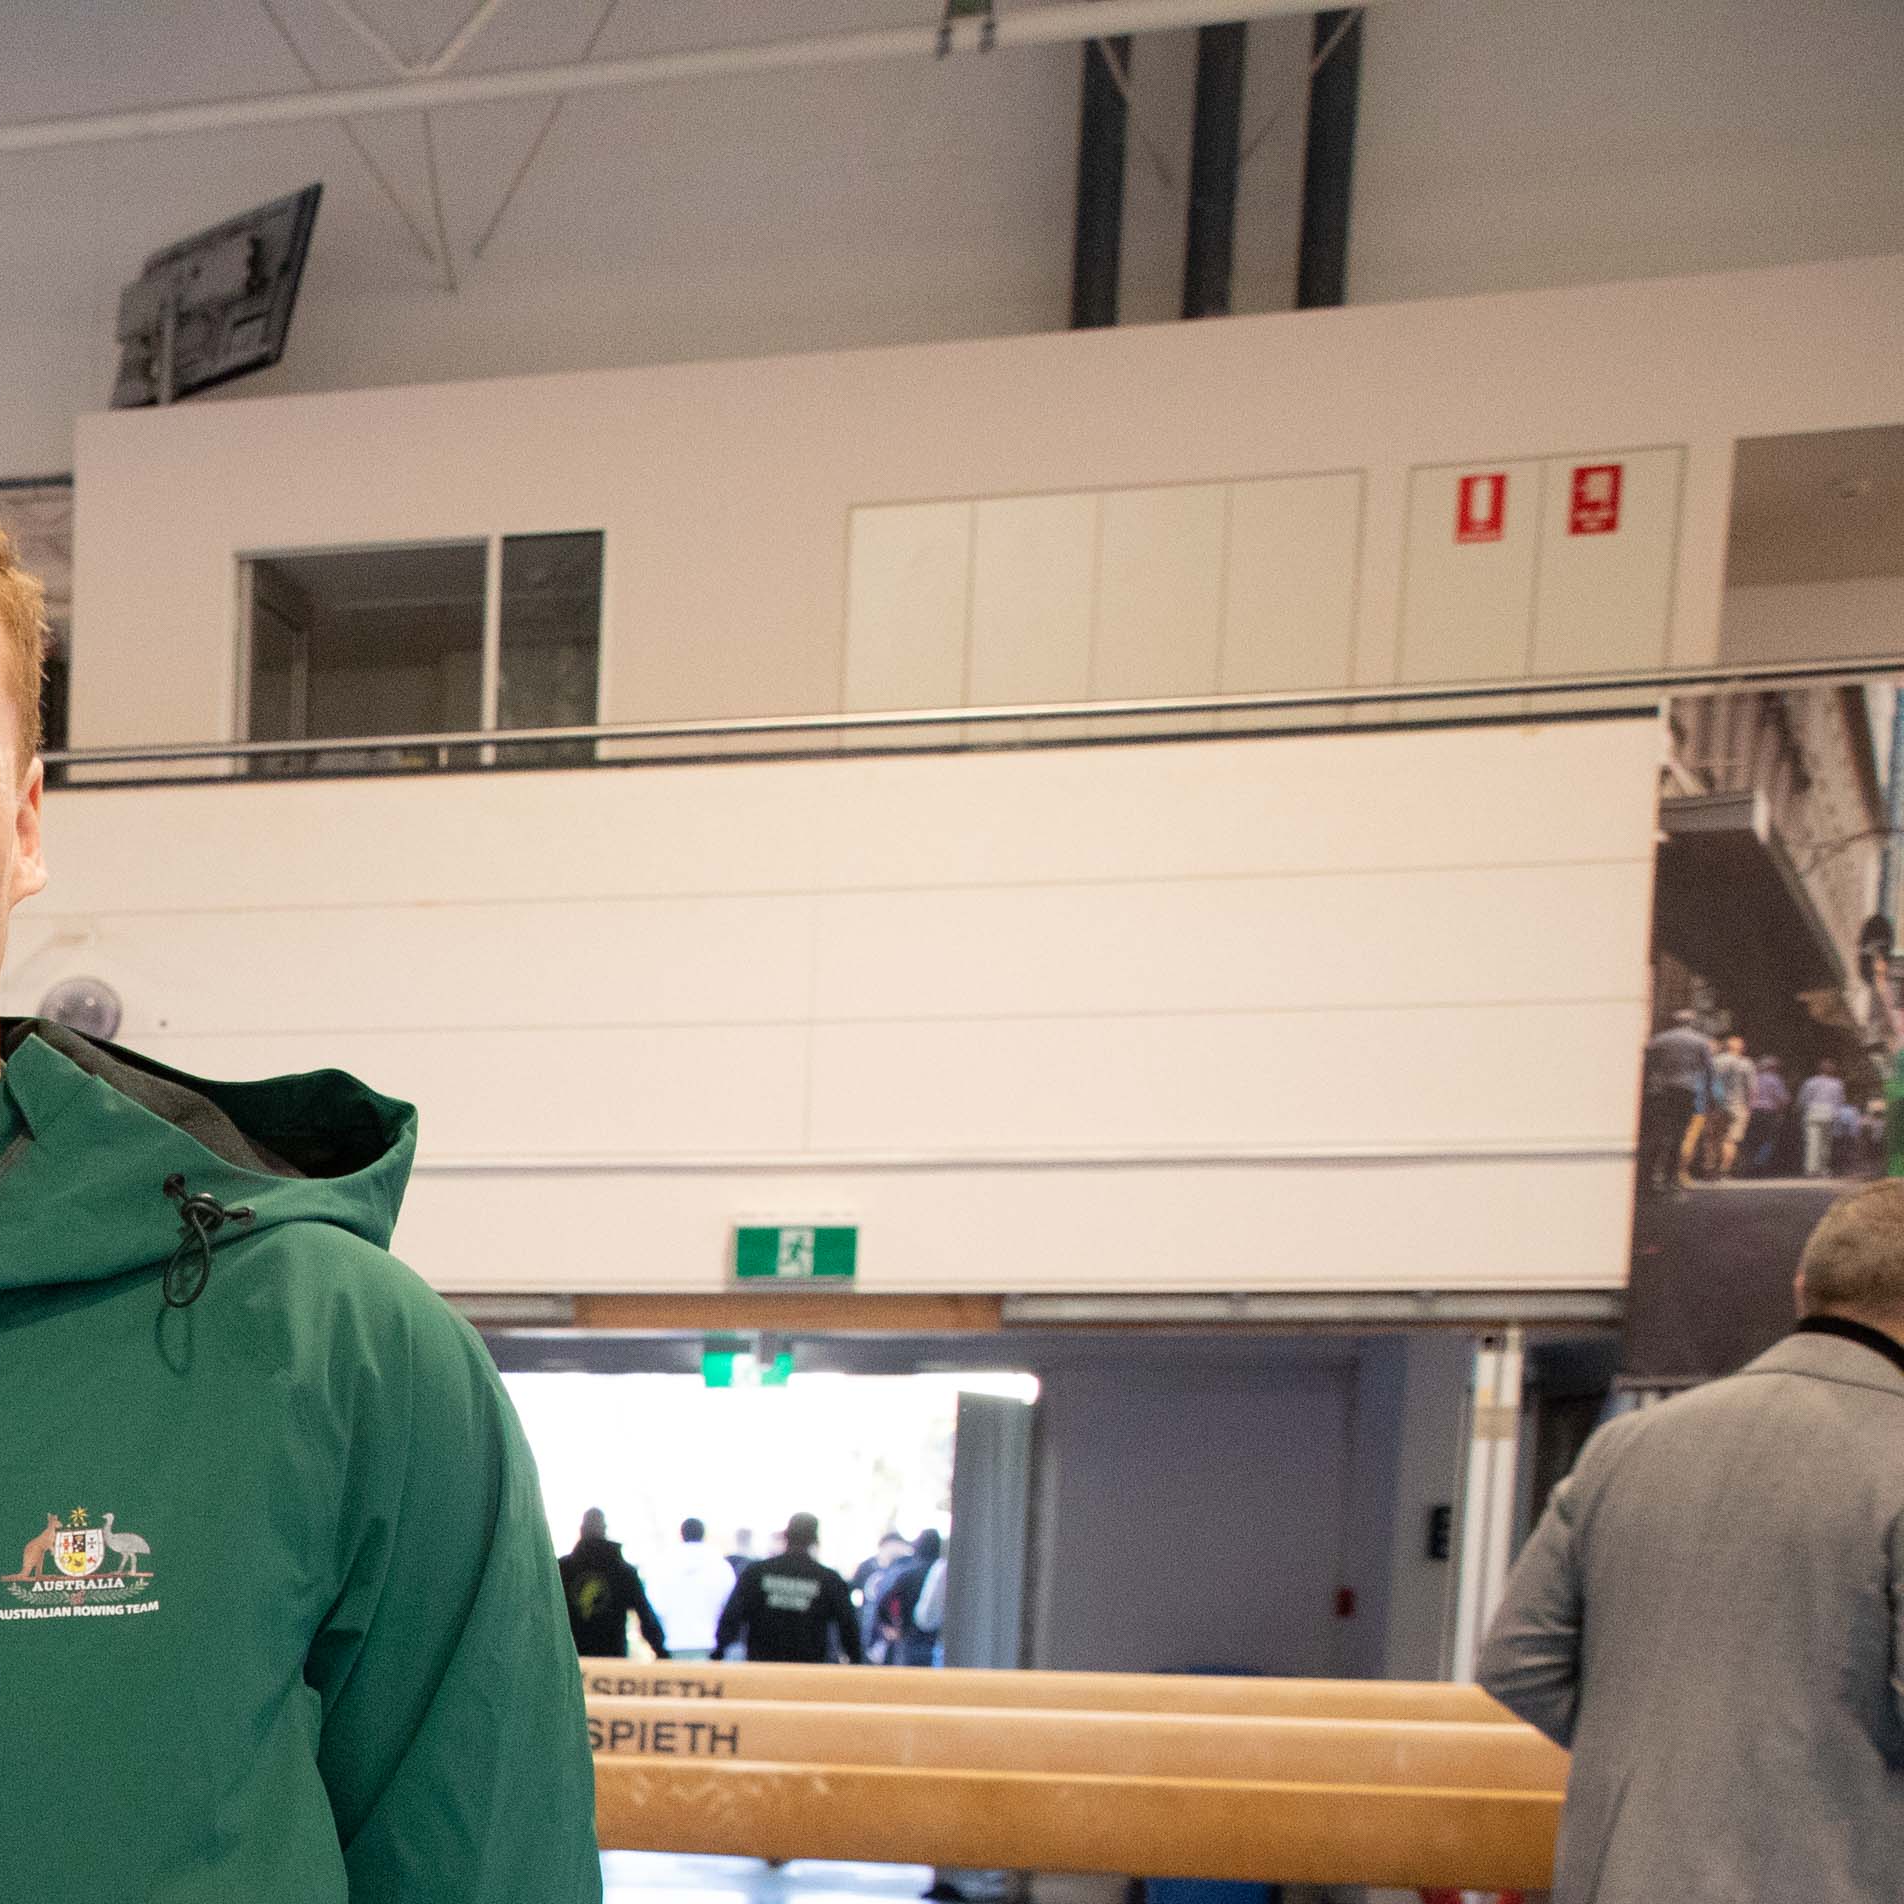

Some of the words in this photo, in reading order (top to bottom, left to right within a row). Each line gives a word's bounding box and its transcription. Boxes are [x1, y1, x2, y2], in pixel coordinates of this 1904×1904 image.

[32, 1578, 125, 1592] AUSTRALIA
[73, 1604, 124, 1617] ROWING
[125, 1600, 160, 1614] TEAM
[586, 1717, 739, 1753] SPIETH
